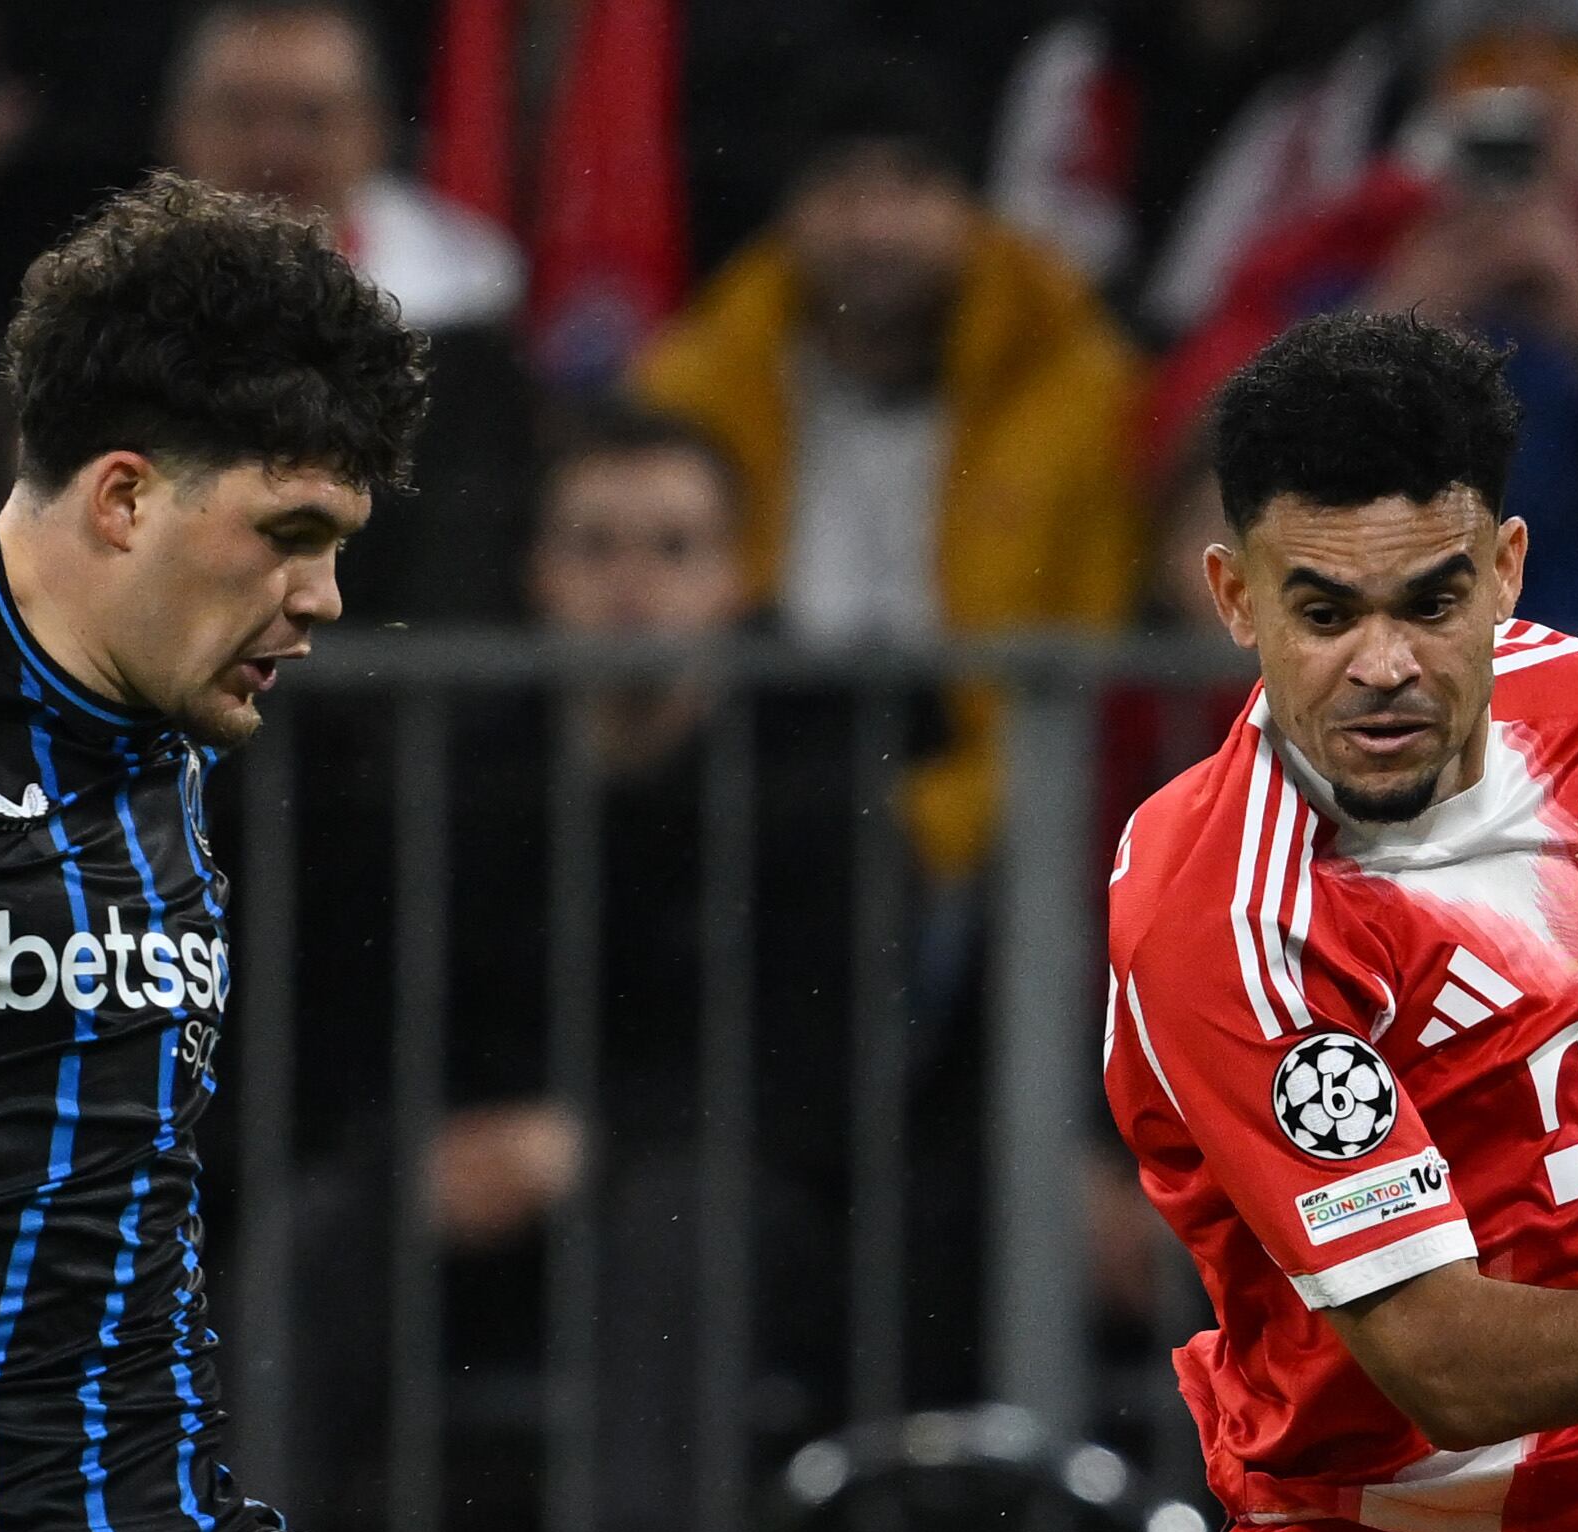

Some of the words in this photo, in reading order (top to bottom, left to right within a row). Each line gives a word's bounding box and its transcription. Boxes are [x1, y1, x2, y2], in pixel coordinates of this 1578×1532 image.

[1322, 1072, 1356, 1120] 6
[1409, 1164, 1442, 1194] 10
[1301, 1192, 1329, 1208] UEFA
[1305, 1180, 1412, 1227] FOUNDATION
